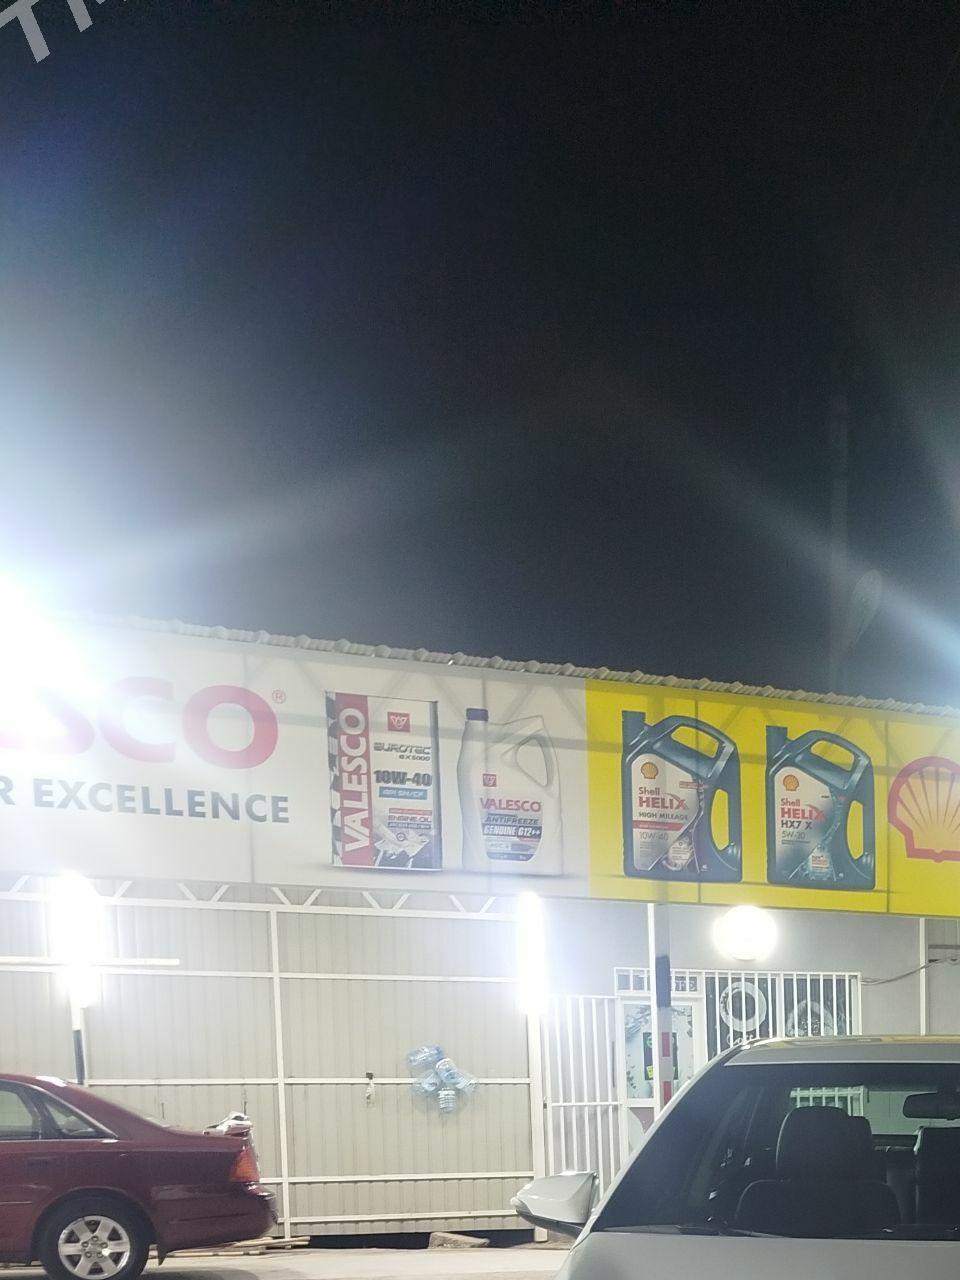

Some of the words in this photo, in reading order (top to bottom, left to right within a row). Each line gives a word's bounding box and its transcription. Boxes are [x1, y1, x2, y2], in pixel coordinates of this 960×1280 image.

[373, 741, 432, 755] EUROTEC
[339, 707, 371, 852] VALESCO
[373, 770, 433, 788] 10W-40
[638, 786, 661, 796] Shell
[33, 778, 290, 824] EXCELLENCE
[480, 797, 542, 812] VALESCO
[638, 796, 688, 810] HELIX
[780, 798, 801, 807] Shell
[638, 811, 657, 819] HIGH
[659, 812, 688, 821] MILEAGE
[780, 807, 826, 820] HELIX
[485, 816, 541, 826] ANTIFREEZE
[781, 819, 802, 829] HX7
[483, 825, 517, 836] GENUINE
